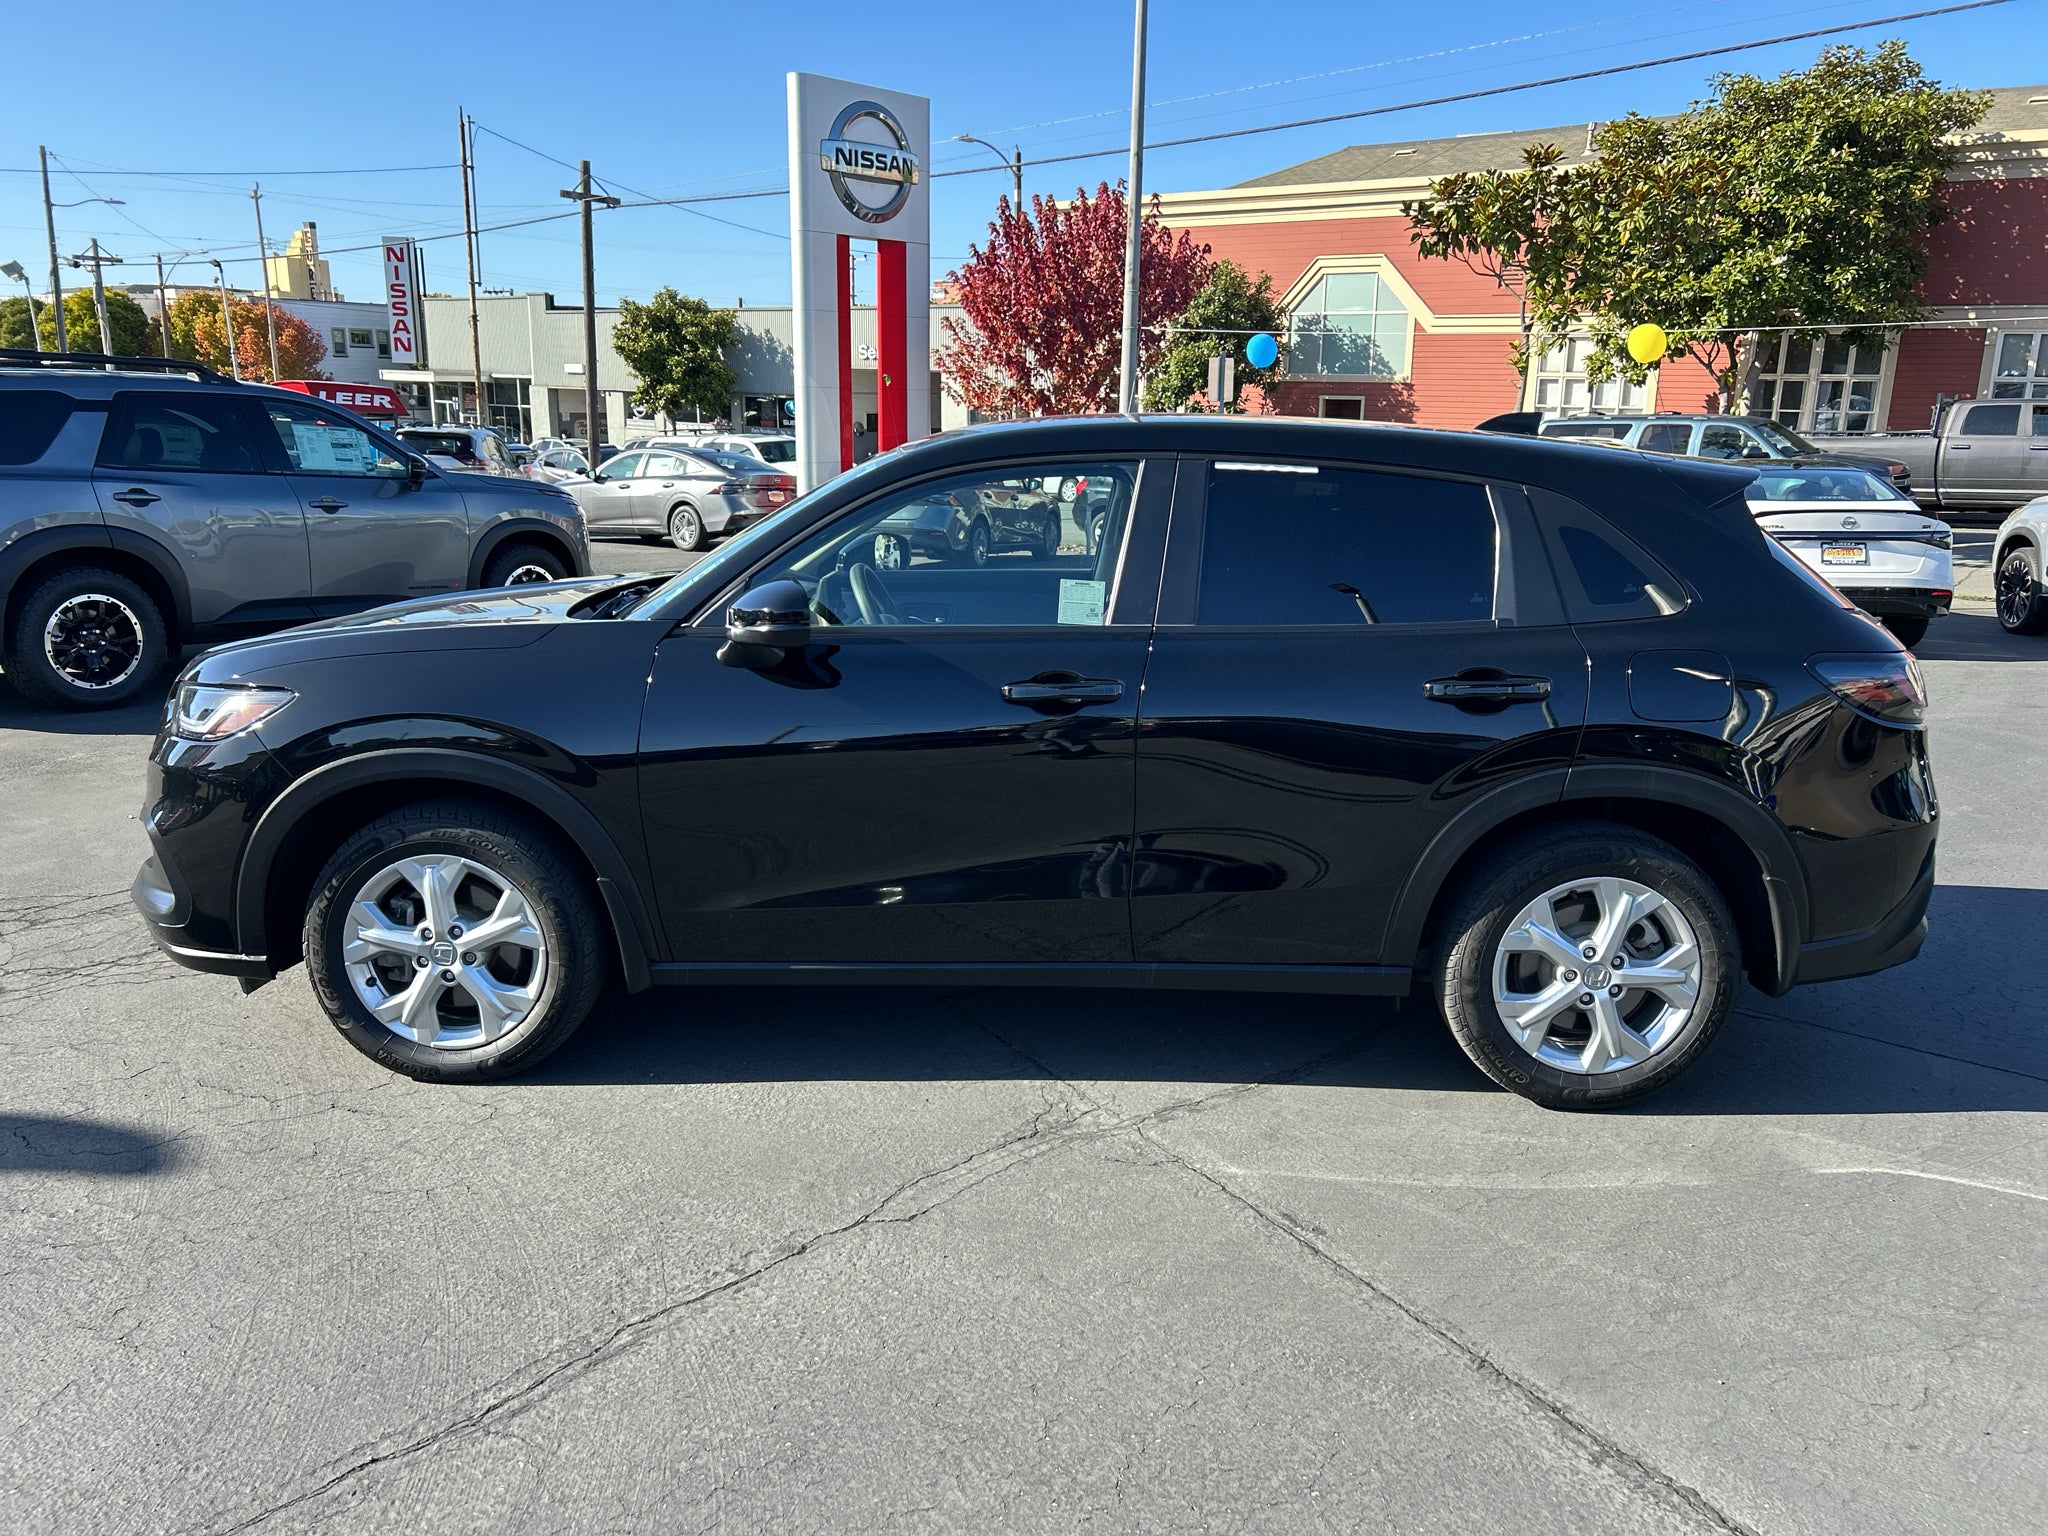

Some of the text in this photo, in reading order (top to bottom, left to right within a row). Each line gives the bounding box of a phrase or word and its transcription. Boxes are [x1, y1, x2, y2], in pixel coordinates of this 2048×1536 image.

[835, 147, 913, 176] NISSAN
[386, 246, 412, 352] NISSAN
[858, 344, 878, 360] Se
[318, 390, 393, 409] LEER
[312, 872, 343, 1002] CONFIDENCE
